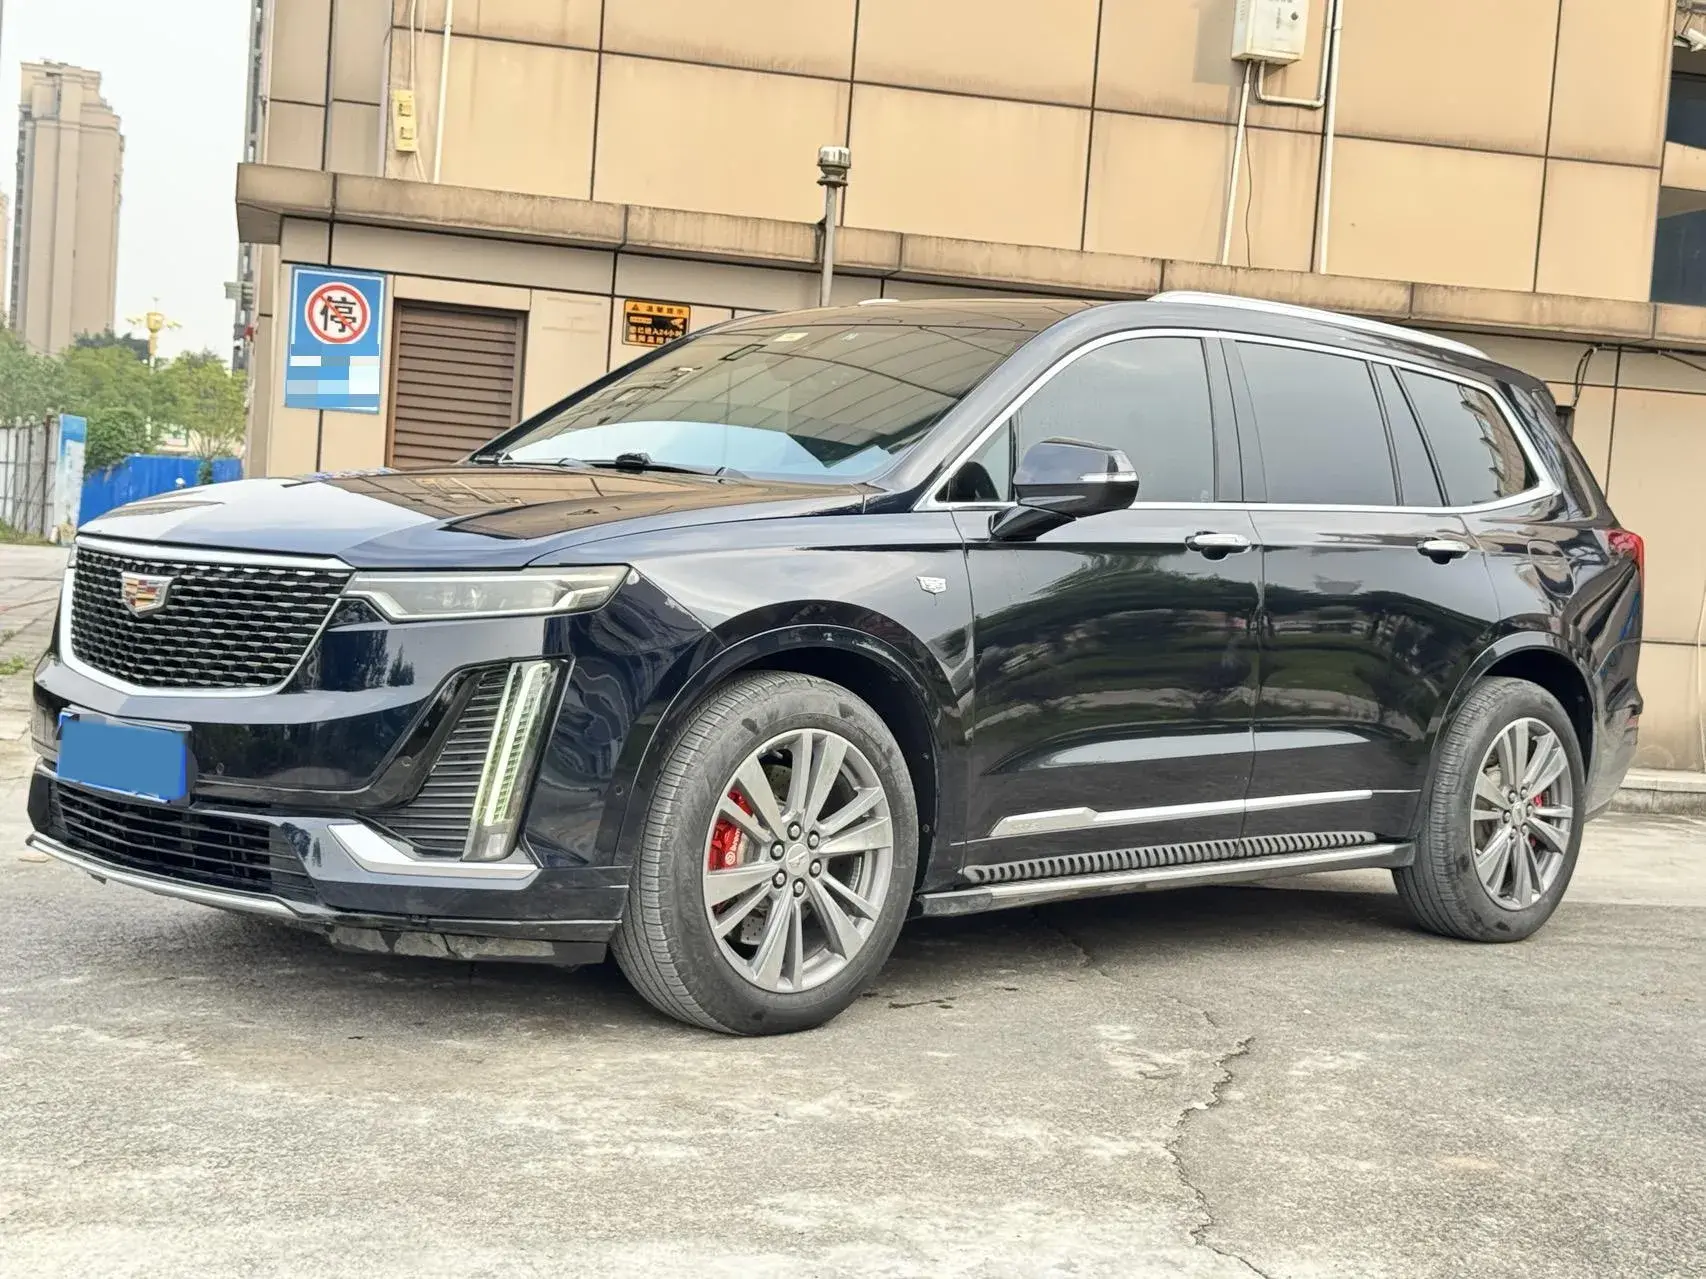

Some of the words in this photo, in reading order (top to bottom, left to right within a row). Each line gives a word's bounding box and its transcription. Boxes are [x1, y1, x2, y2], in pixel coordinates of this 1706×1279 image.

[319, 295, 357, 333] 停
[646, 305, 684, 315] 温馨提示
